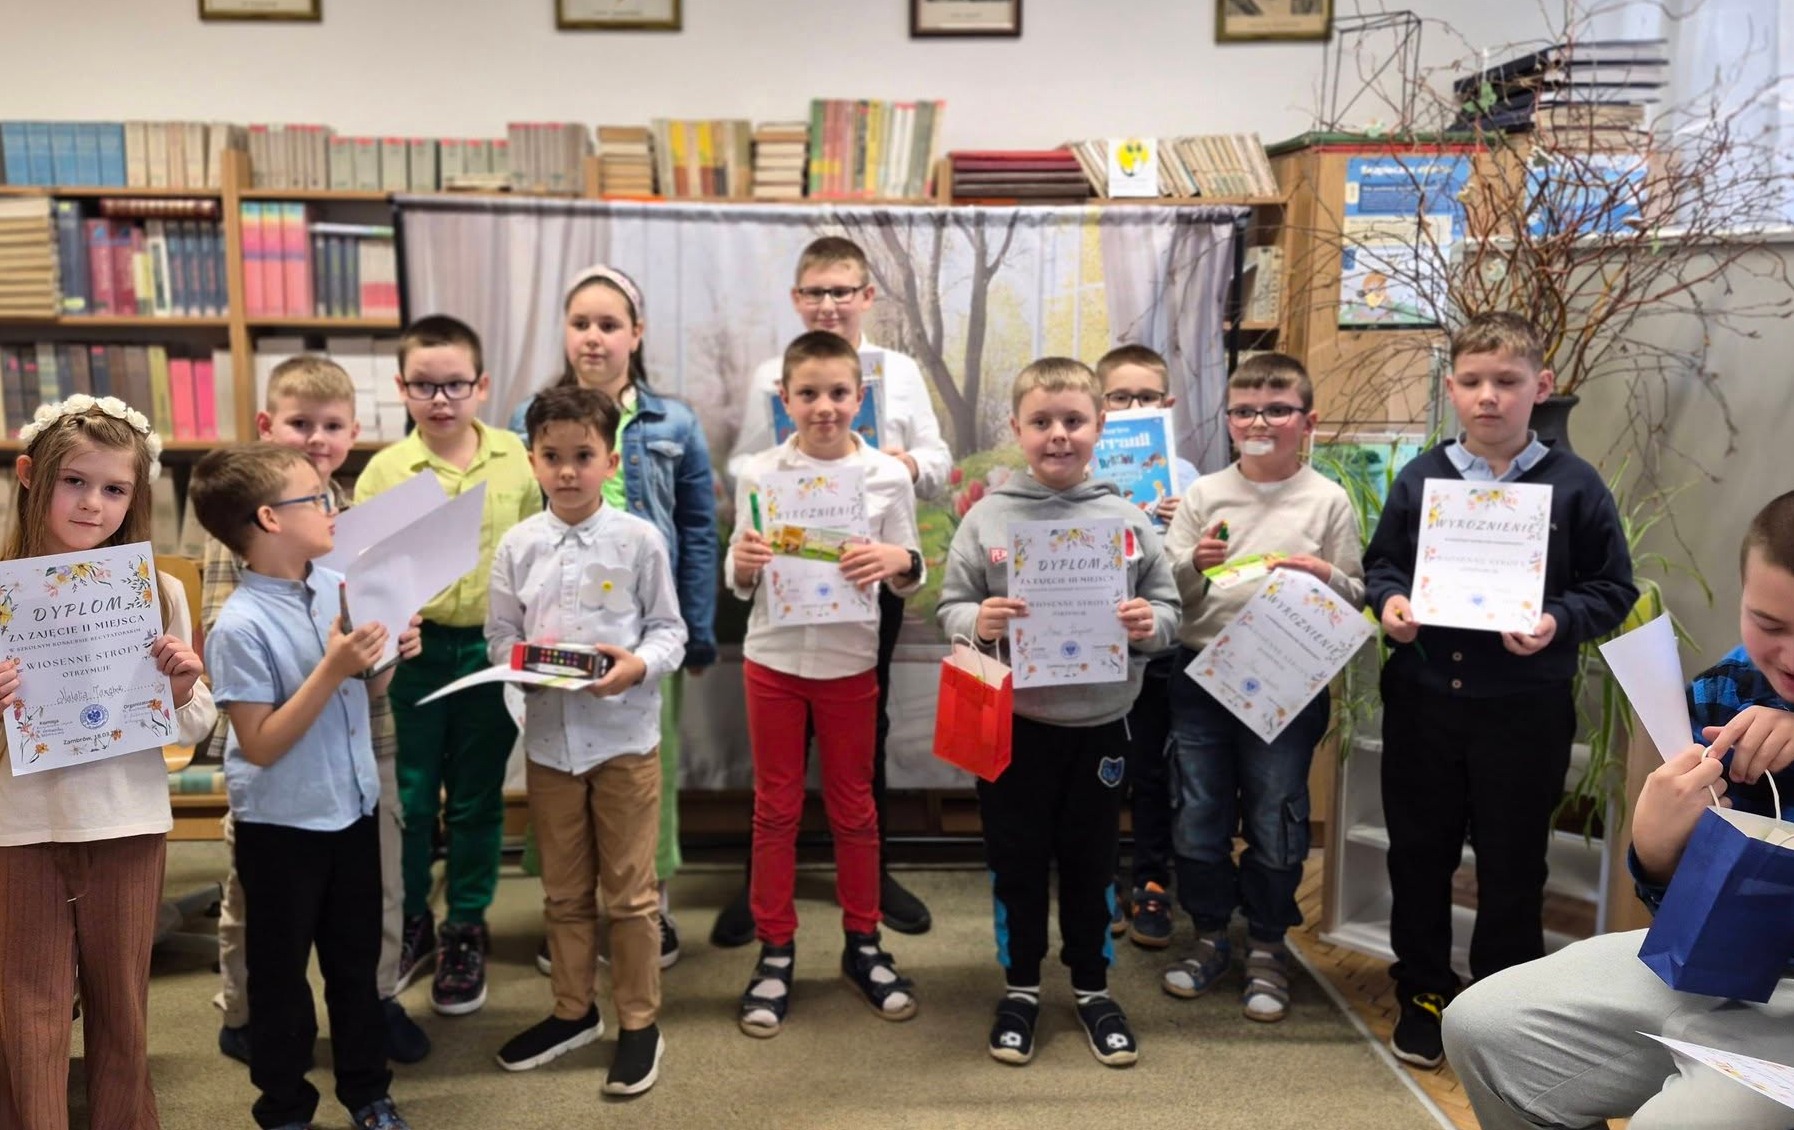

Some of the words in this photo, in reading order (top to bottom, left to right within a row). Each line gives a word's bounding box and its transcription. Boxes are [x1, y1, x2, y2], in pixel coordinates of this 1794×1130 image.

[1038, 557, 1100, 571] DYPLOM
[33, 596, 122, 622] DYPLOM
[9, 634, 24, 643] ZA
[27, 626, 78, 640] ZAJĘCIE
[82, 624, 91, 632] II
[95, 614, 145, 630] MIEJSCA
[17, 643, 51, 652] SZKOLNYM
[52, 638, 88, 647] KONKURSIE
[26, 654, 91, 670] WIOSENNE
[95, 645, 140, 660] STROFY
[62, 665, 111, 678] OTRZYMUJE
